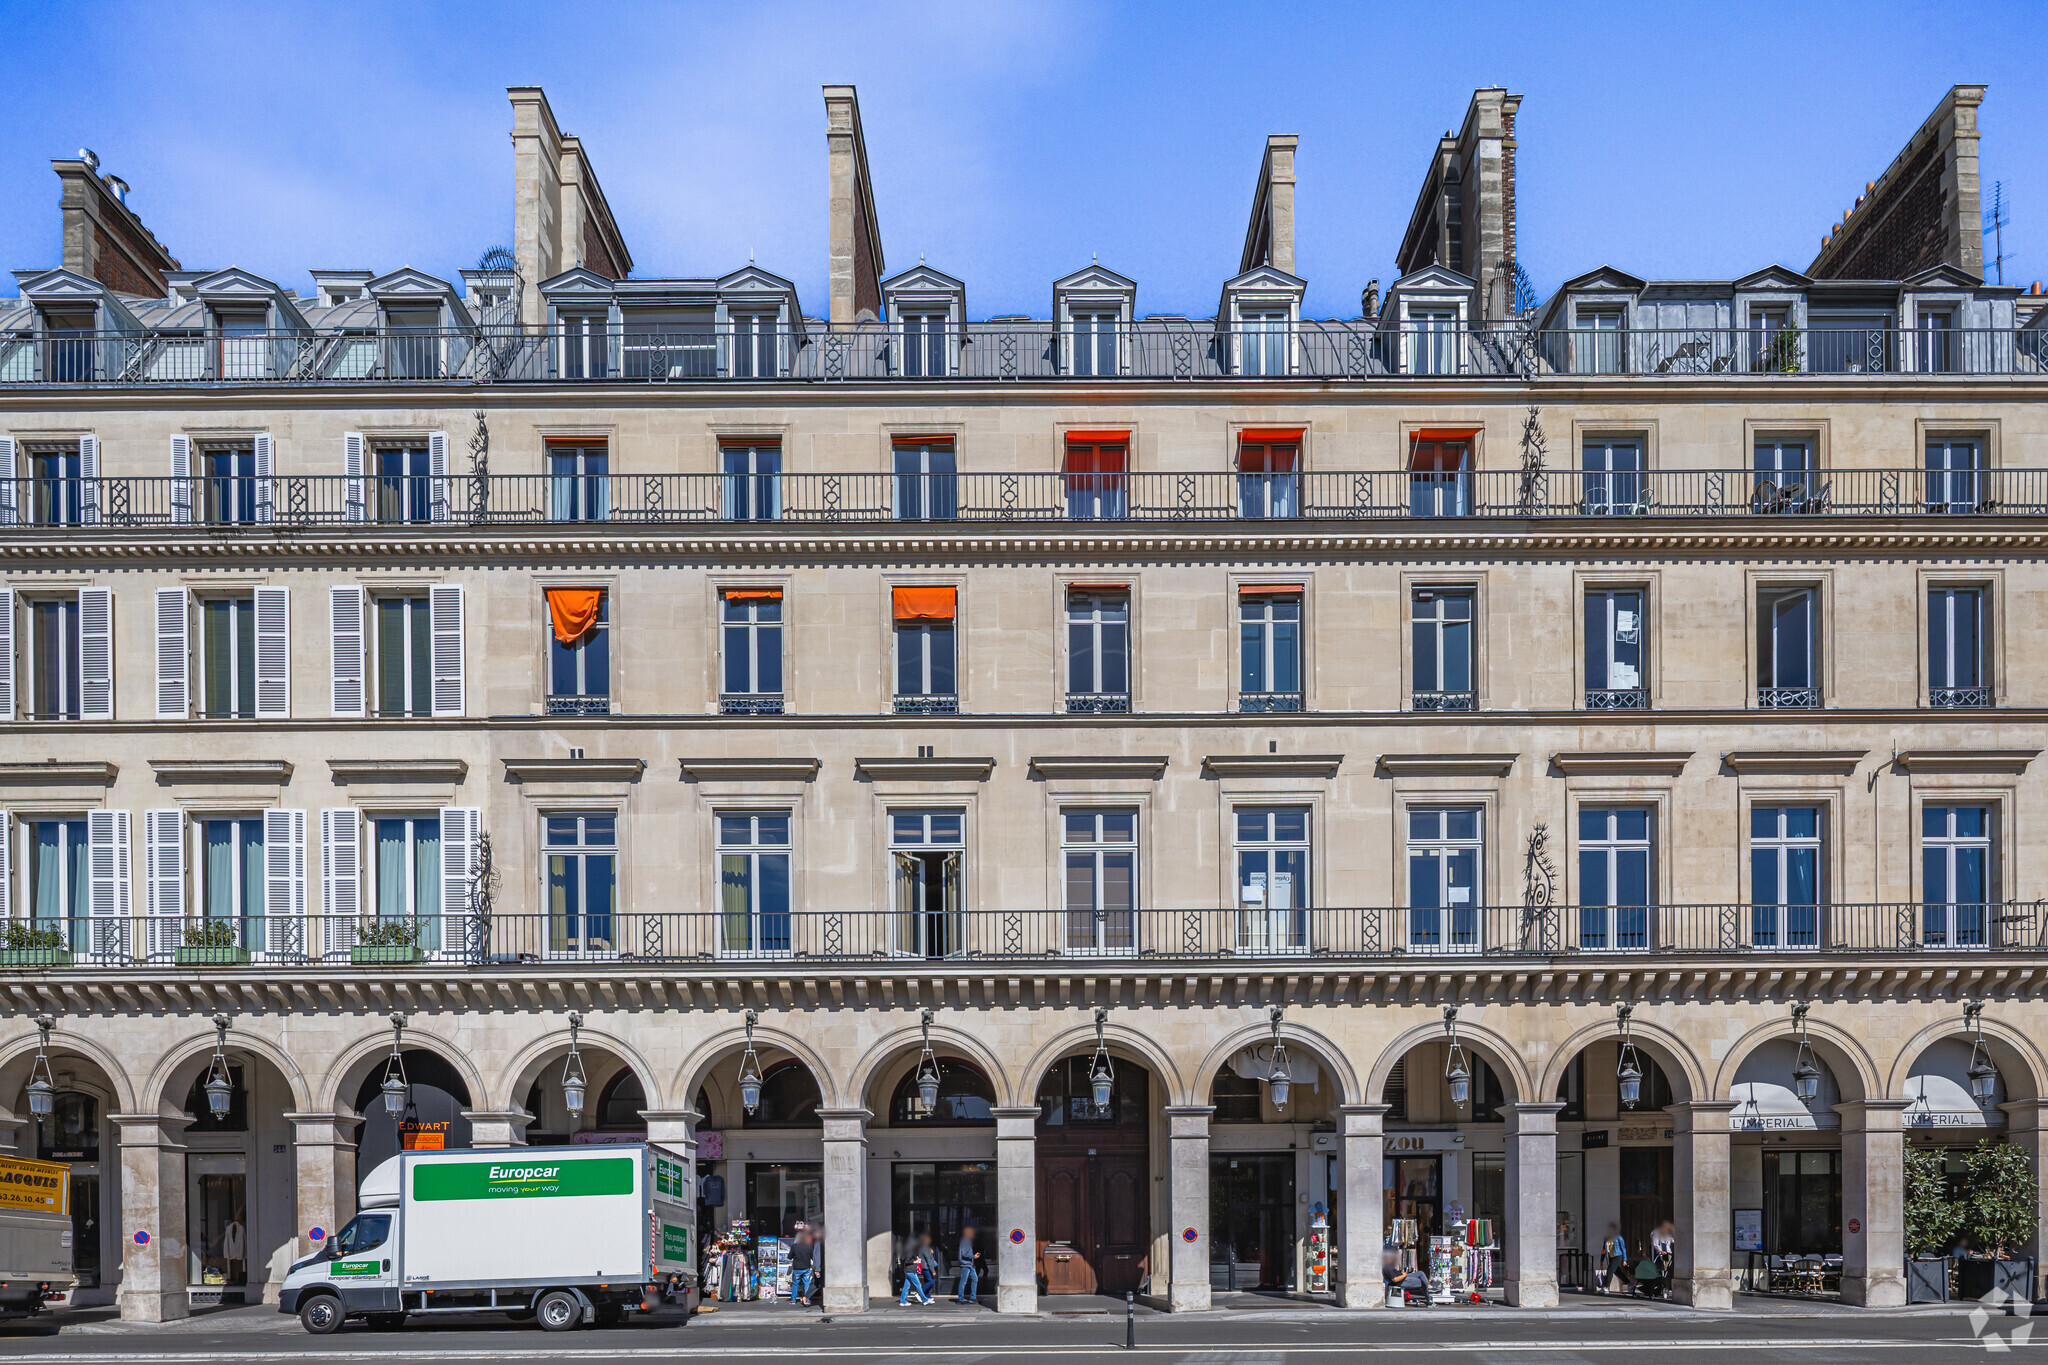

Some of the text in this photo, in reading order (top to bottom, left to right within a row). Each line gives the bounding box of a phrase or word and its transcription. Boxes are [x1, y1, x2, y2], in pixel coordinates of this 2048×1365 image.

[1733, 1118, 1804, 1129] L'IMPERIAL
[1903, 1115, 1969, 1125] 'IMPERIAL
[399, 1121, 450, 1130] EDWART
[489, 1166, 560, 1182] Europcar
[489, 1185, 559, 1194] moving your way
[665, 1231, 673, 1241] Plus
